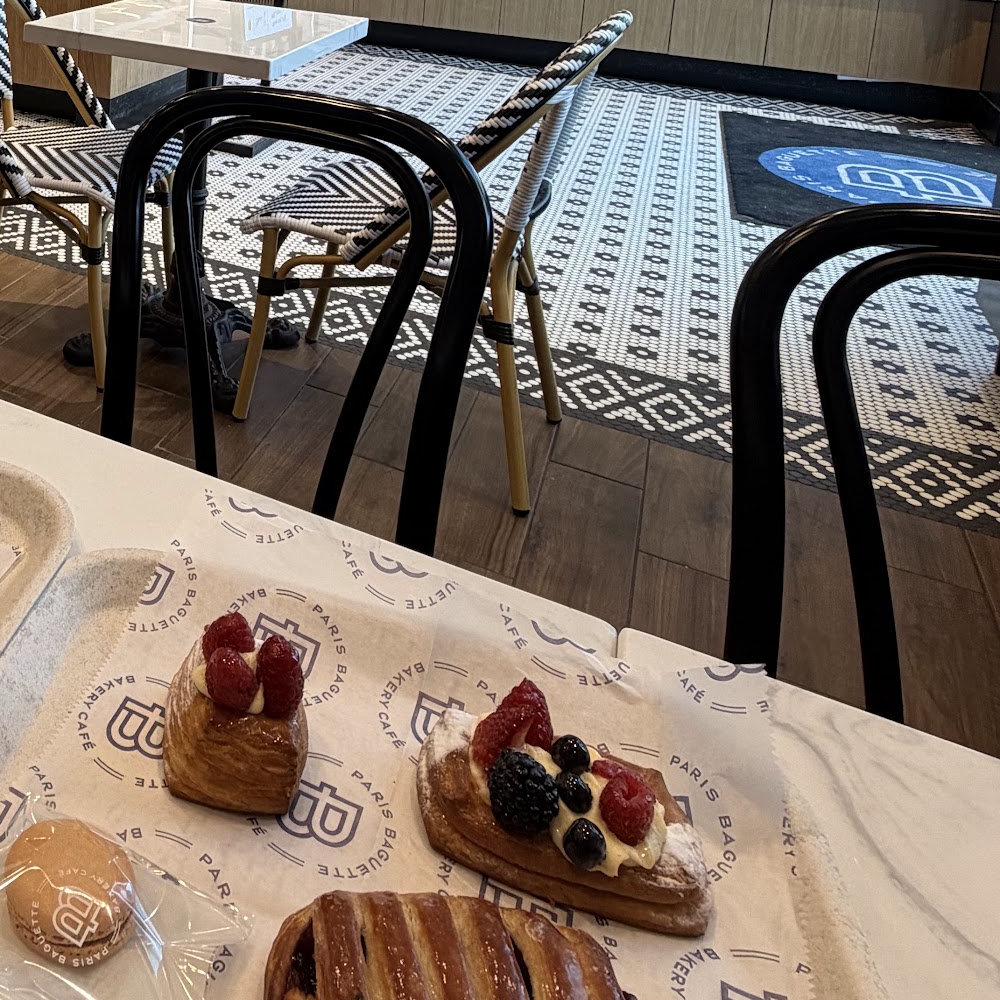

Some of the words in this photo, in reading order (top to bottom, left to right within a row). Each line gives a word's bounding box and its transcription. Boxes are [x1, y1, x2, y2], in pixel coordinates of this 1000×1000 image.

[255, 524, 304, 544] UETTE
[170, 539, 198, 581] PARIS
[127, 588, 197, 632] BAGUETTE
[228, 588, 267, 613] BAKE
[404, 580, 460, 610] UETTE
[312, 604, 346, 655] PARIS
[83, 674, 136, 710] BAKERY
[303, 664, 348, 707] BAGUET
[379, 662, 425, 712] BAKERY
[576, 661, 630, 686] UETTE
[676, 669, 706, 703] AFÉ
[77, 711, 97, 752] CAFÉ
[378, 711, 407, 749] CAFÉ
[28, 765, 57, 810] PARIS
[351, 769, 394, 820] PARIS
[246, 817, 268, 836] FÉ
[670, 755, 719, 802] PARIS
[707, 814, 737, 882] BAGUE
[317, 827, 397, 879] BAGUETTE
[31, 900, 67, 964] BAGUETTE
[72, 946, 109, 968] PARIS
[670, 947, 721, 1000] BAKERY
